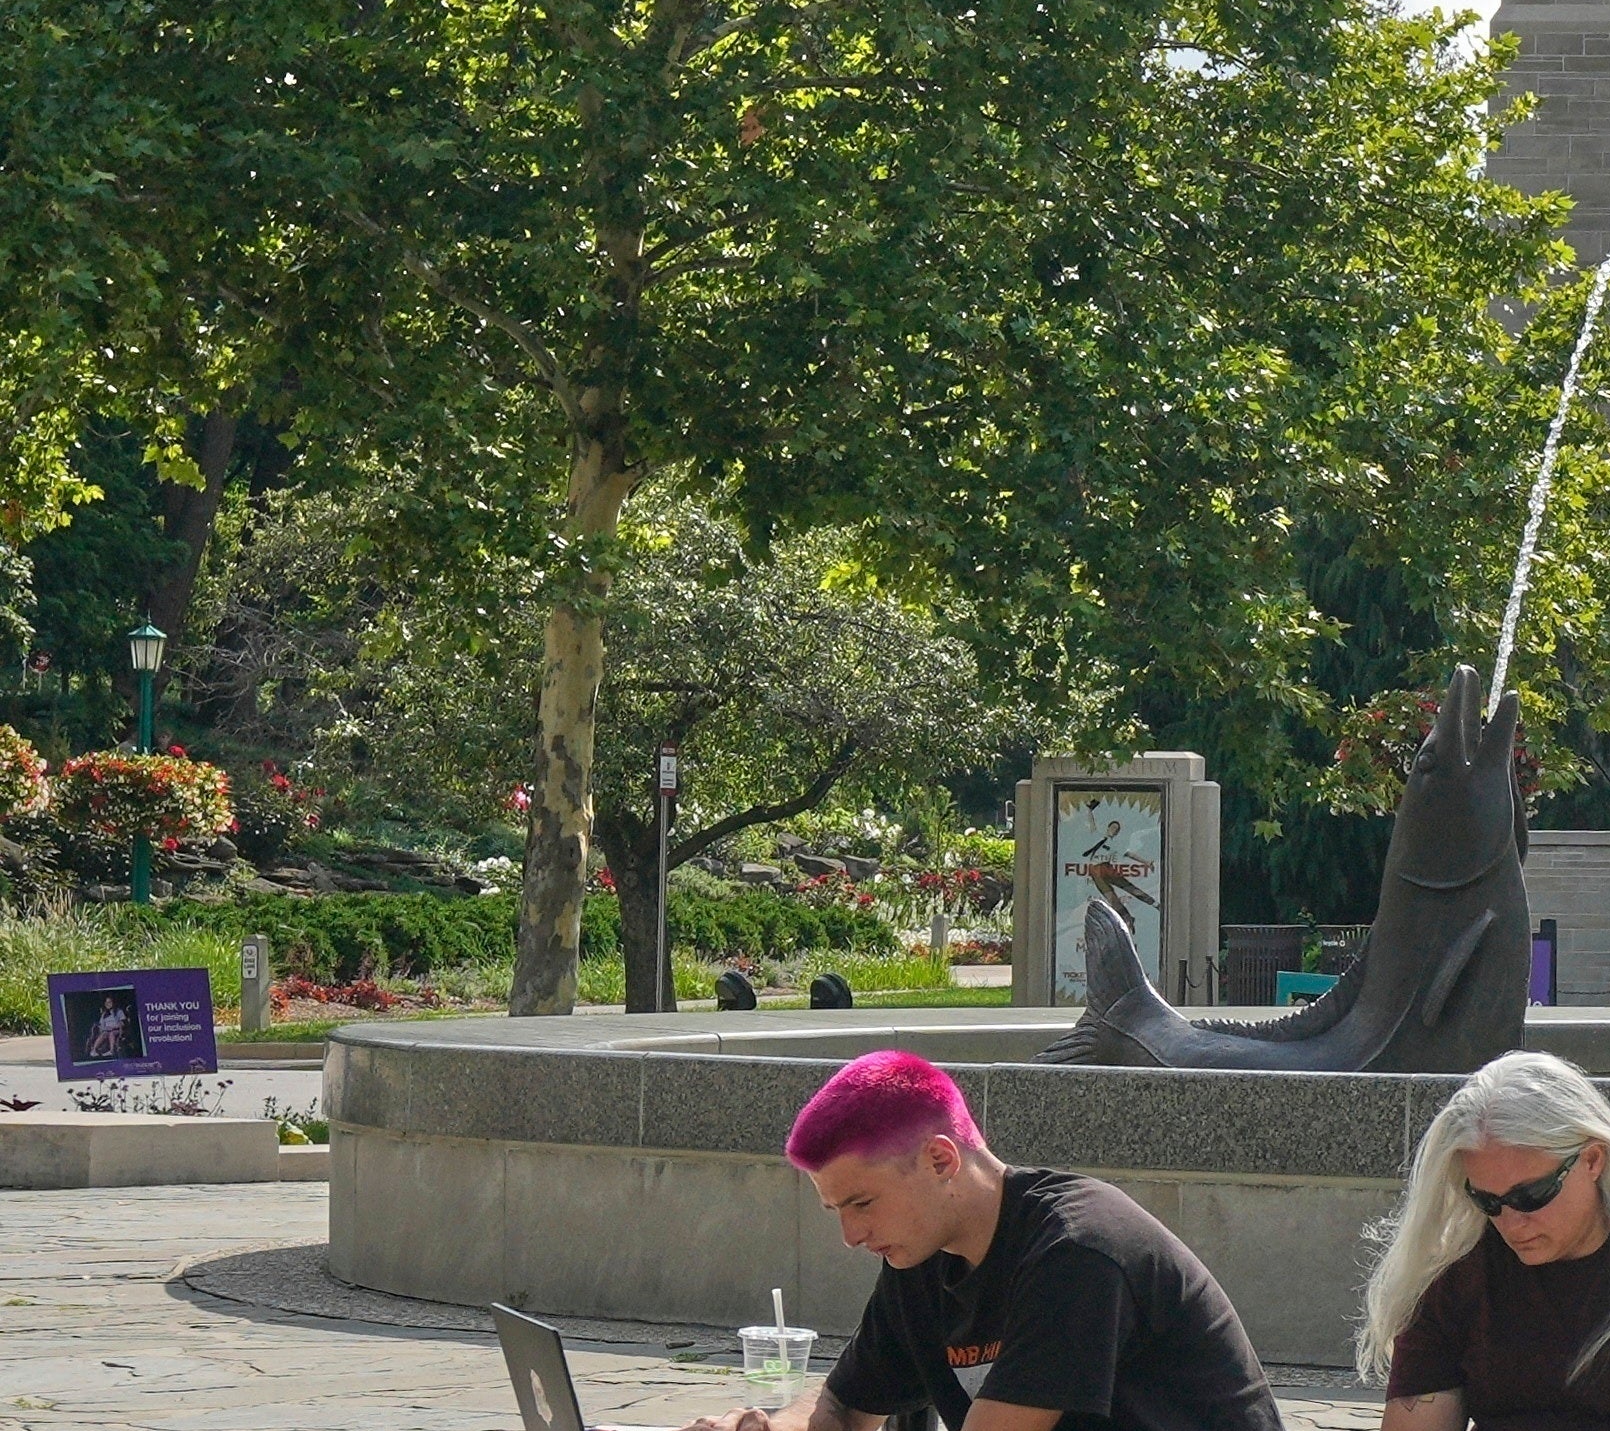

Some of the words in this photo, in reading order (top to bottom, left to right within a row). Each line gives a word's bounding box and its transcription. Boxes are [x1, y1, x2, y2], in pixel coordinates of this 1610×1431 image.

[1064, 862, 1150, 878] FUIEST
[145, 1002, 177, 1011] THANK
[179, 1001, 200, 1010] YOU
